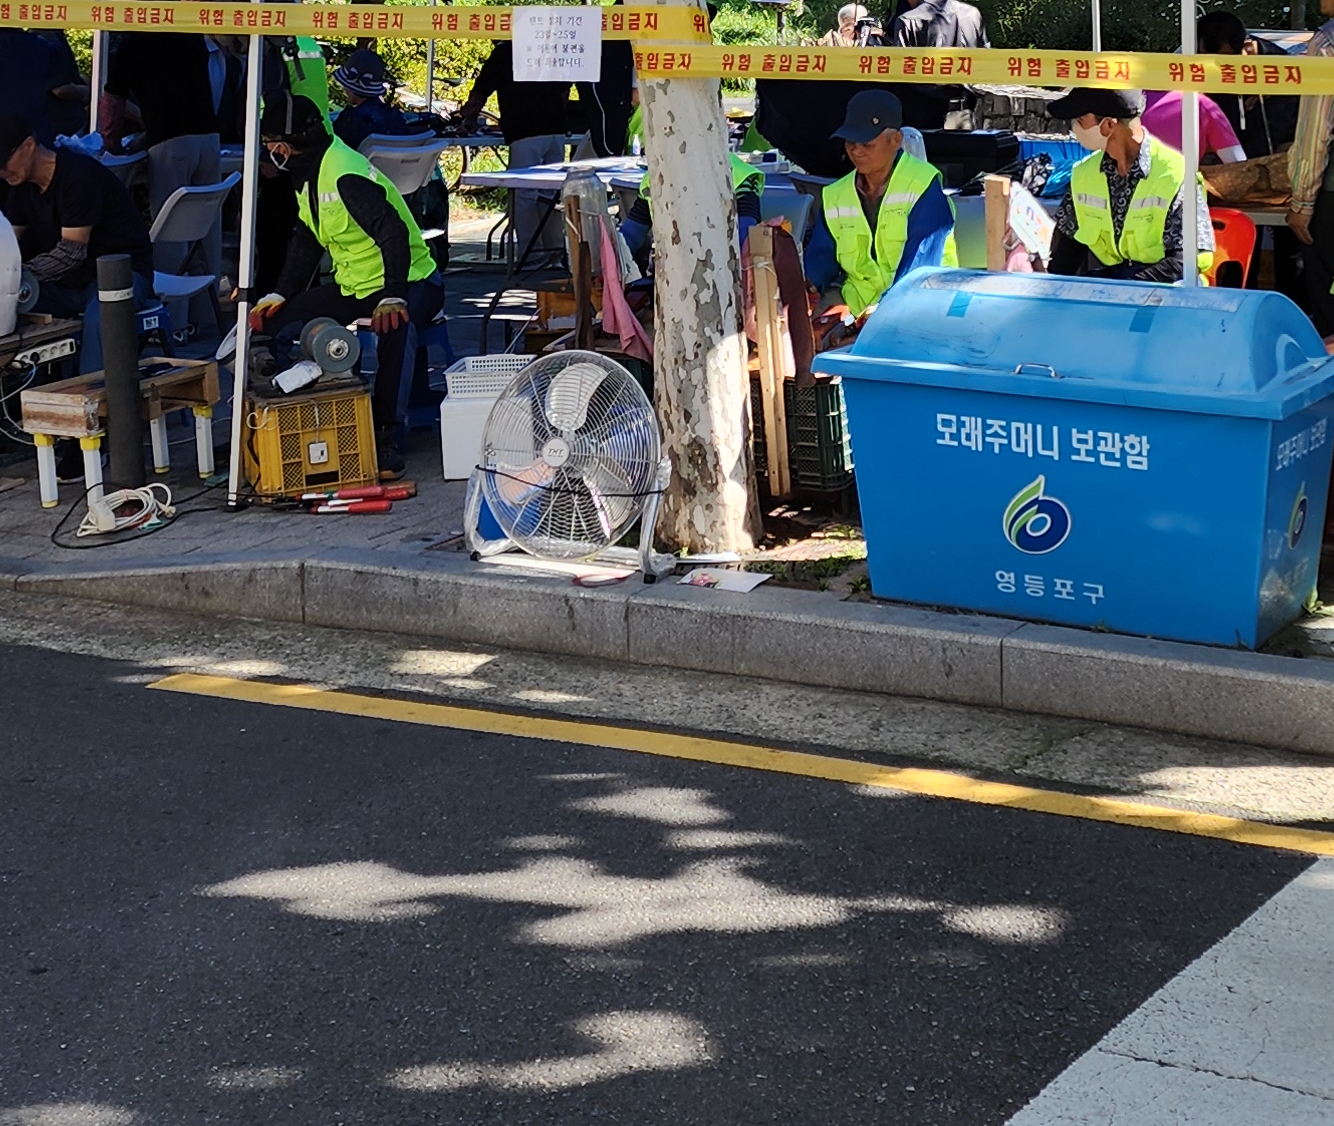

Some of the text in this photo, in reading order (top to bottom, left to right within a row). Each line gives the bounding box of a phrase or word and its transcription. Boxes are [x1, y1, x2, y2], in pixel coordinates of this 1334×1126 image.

[19, 4, 67, 22] 출입금지
[91, 5, 114, 23] 위험
[123, 7, 175, 24] 출입금지
[199, 8, 224, 26] 위험
[233, 9, 286, 28] 출입금지
[312, 11, 339, 29] 위험
[348, 11, 404, 30] 출입금지
[431, 13, 459, 30] 위험
[468, 13, 512, 32] 출입금
[721, 54, 751, 72] 위험
[762, 54, 827, 73] 출입금지
[858, 55, 891, 74] 위험
[902, 55, 972, 75] 출입금지
[1007, 57, 1042, 77] 위험
[1055, 59, 1131, 80] 출입금지
[1168, 62, 1207, 83] 위험
[1219, 64, 1302, 86] 출입금지
[935, 412, 1151, 471] 모래주머니 보관함
[994, 569, 1105, 605] 영등포구
